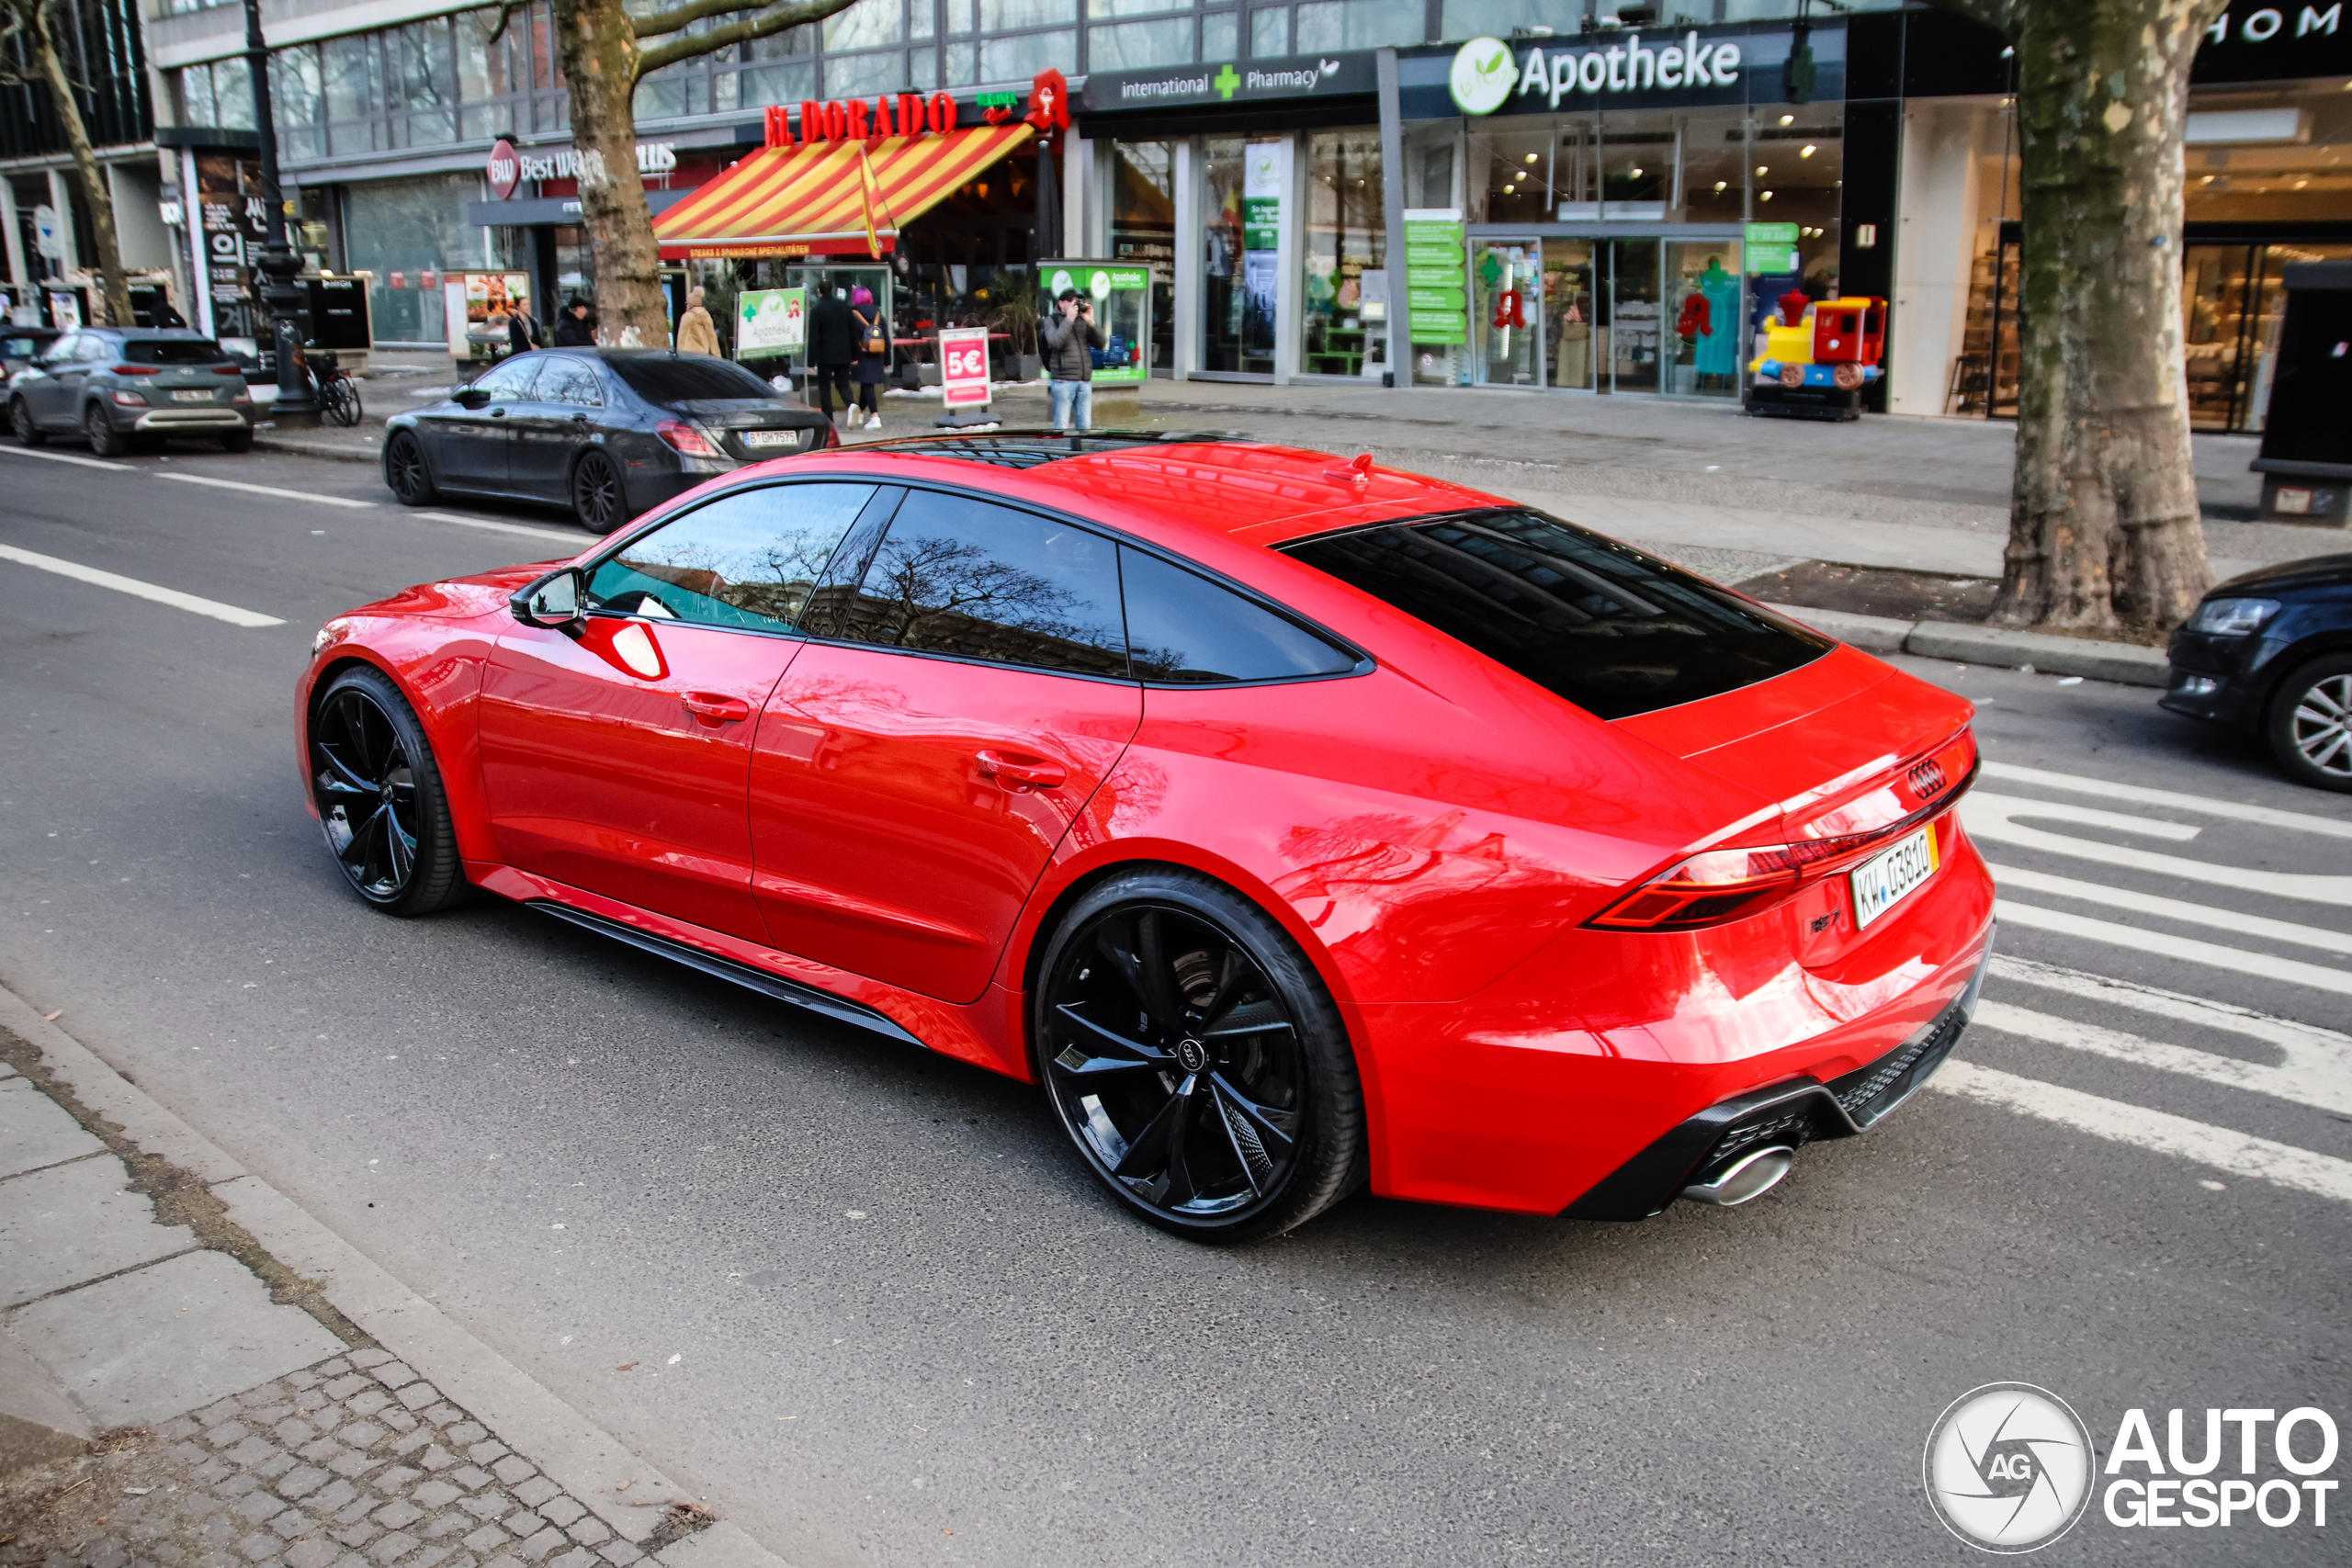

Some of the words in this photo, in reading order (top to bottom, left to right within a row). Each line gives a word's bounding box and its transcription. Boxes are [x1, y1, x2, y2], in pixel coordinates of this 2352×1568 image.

[1518, 30, 1741, 108] Apotheke
[1121, 73, 1209, 97] international
[1247, 69, 1318, 91] Pharmacy
[801, 91, 957, 144] DORADO
[492, 158, 514, 184] BW
[520, 154, 556, 182] Best
[689, 248, 715, 257] STEAKS
[721, 246, 758, 256] SPANISCHE
[1112, 271, 1141, 283] Apotheke
[752, 324, 792, 339] Apotheke
[947, 349, 983, 375] 5€
[1858, 867, 1881, 919] KW
[1810, 914, 1830, 936] RS
